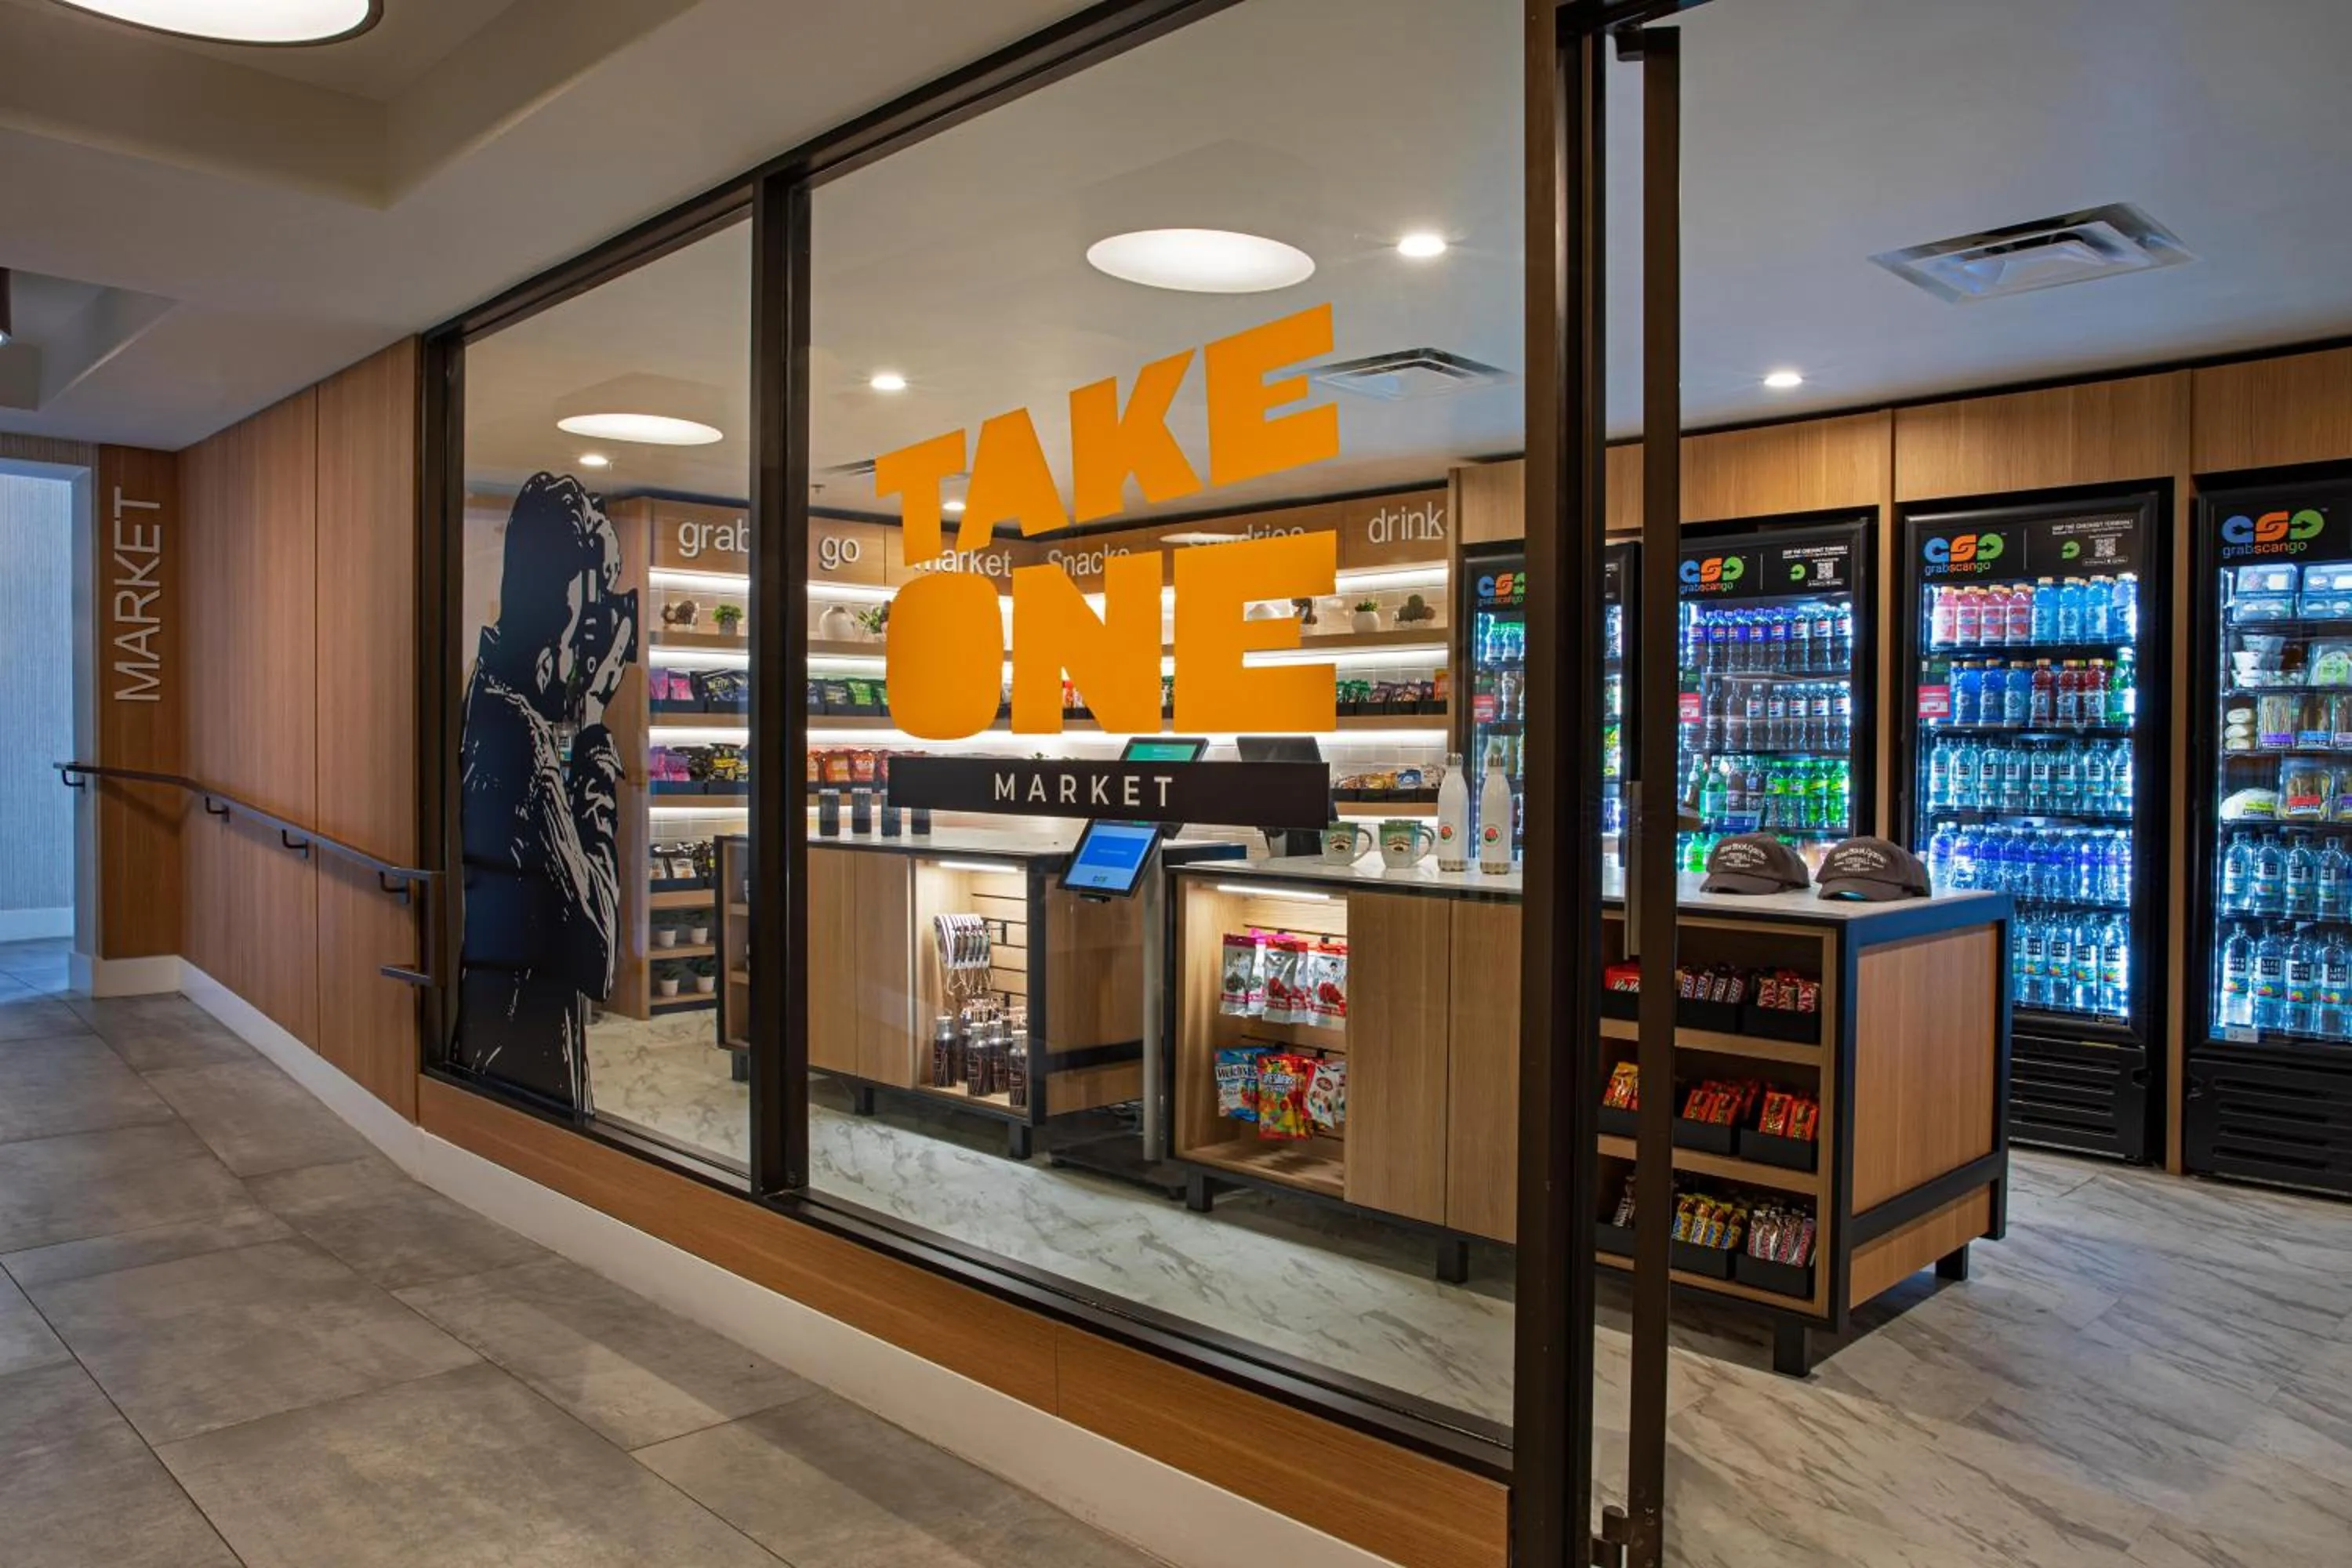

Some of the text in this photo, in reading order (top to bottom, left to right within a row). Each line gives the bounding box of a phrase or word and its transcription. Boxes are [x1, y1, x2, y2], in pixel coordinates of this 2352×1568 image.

[875, 302, 1340, 567] TAKE
[1368, 501, 1449, 543] drink
[819, 536, 860, 570] go
[1925, 561, 1991, 575] grabscango
[2223, 541, 2307, 558] grabscango
[114, 486, 161, 700] MARKET
[886, 530, 1337, 740] ONE
[994, 772, 1173, 806] MARKET
